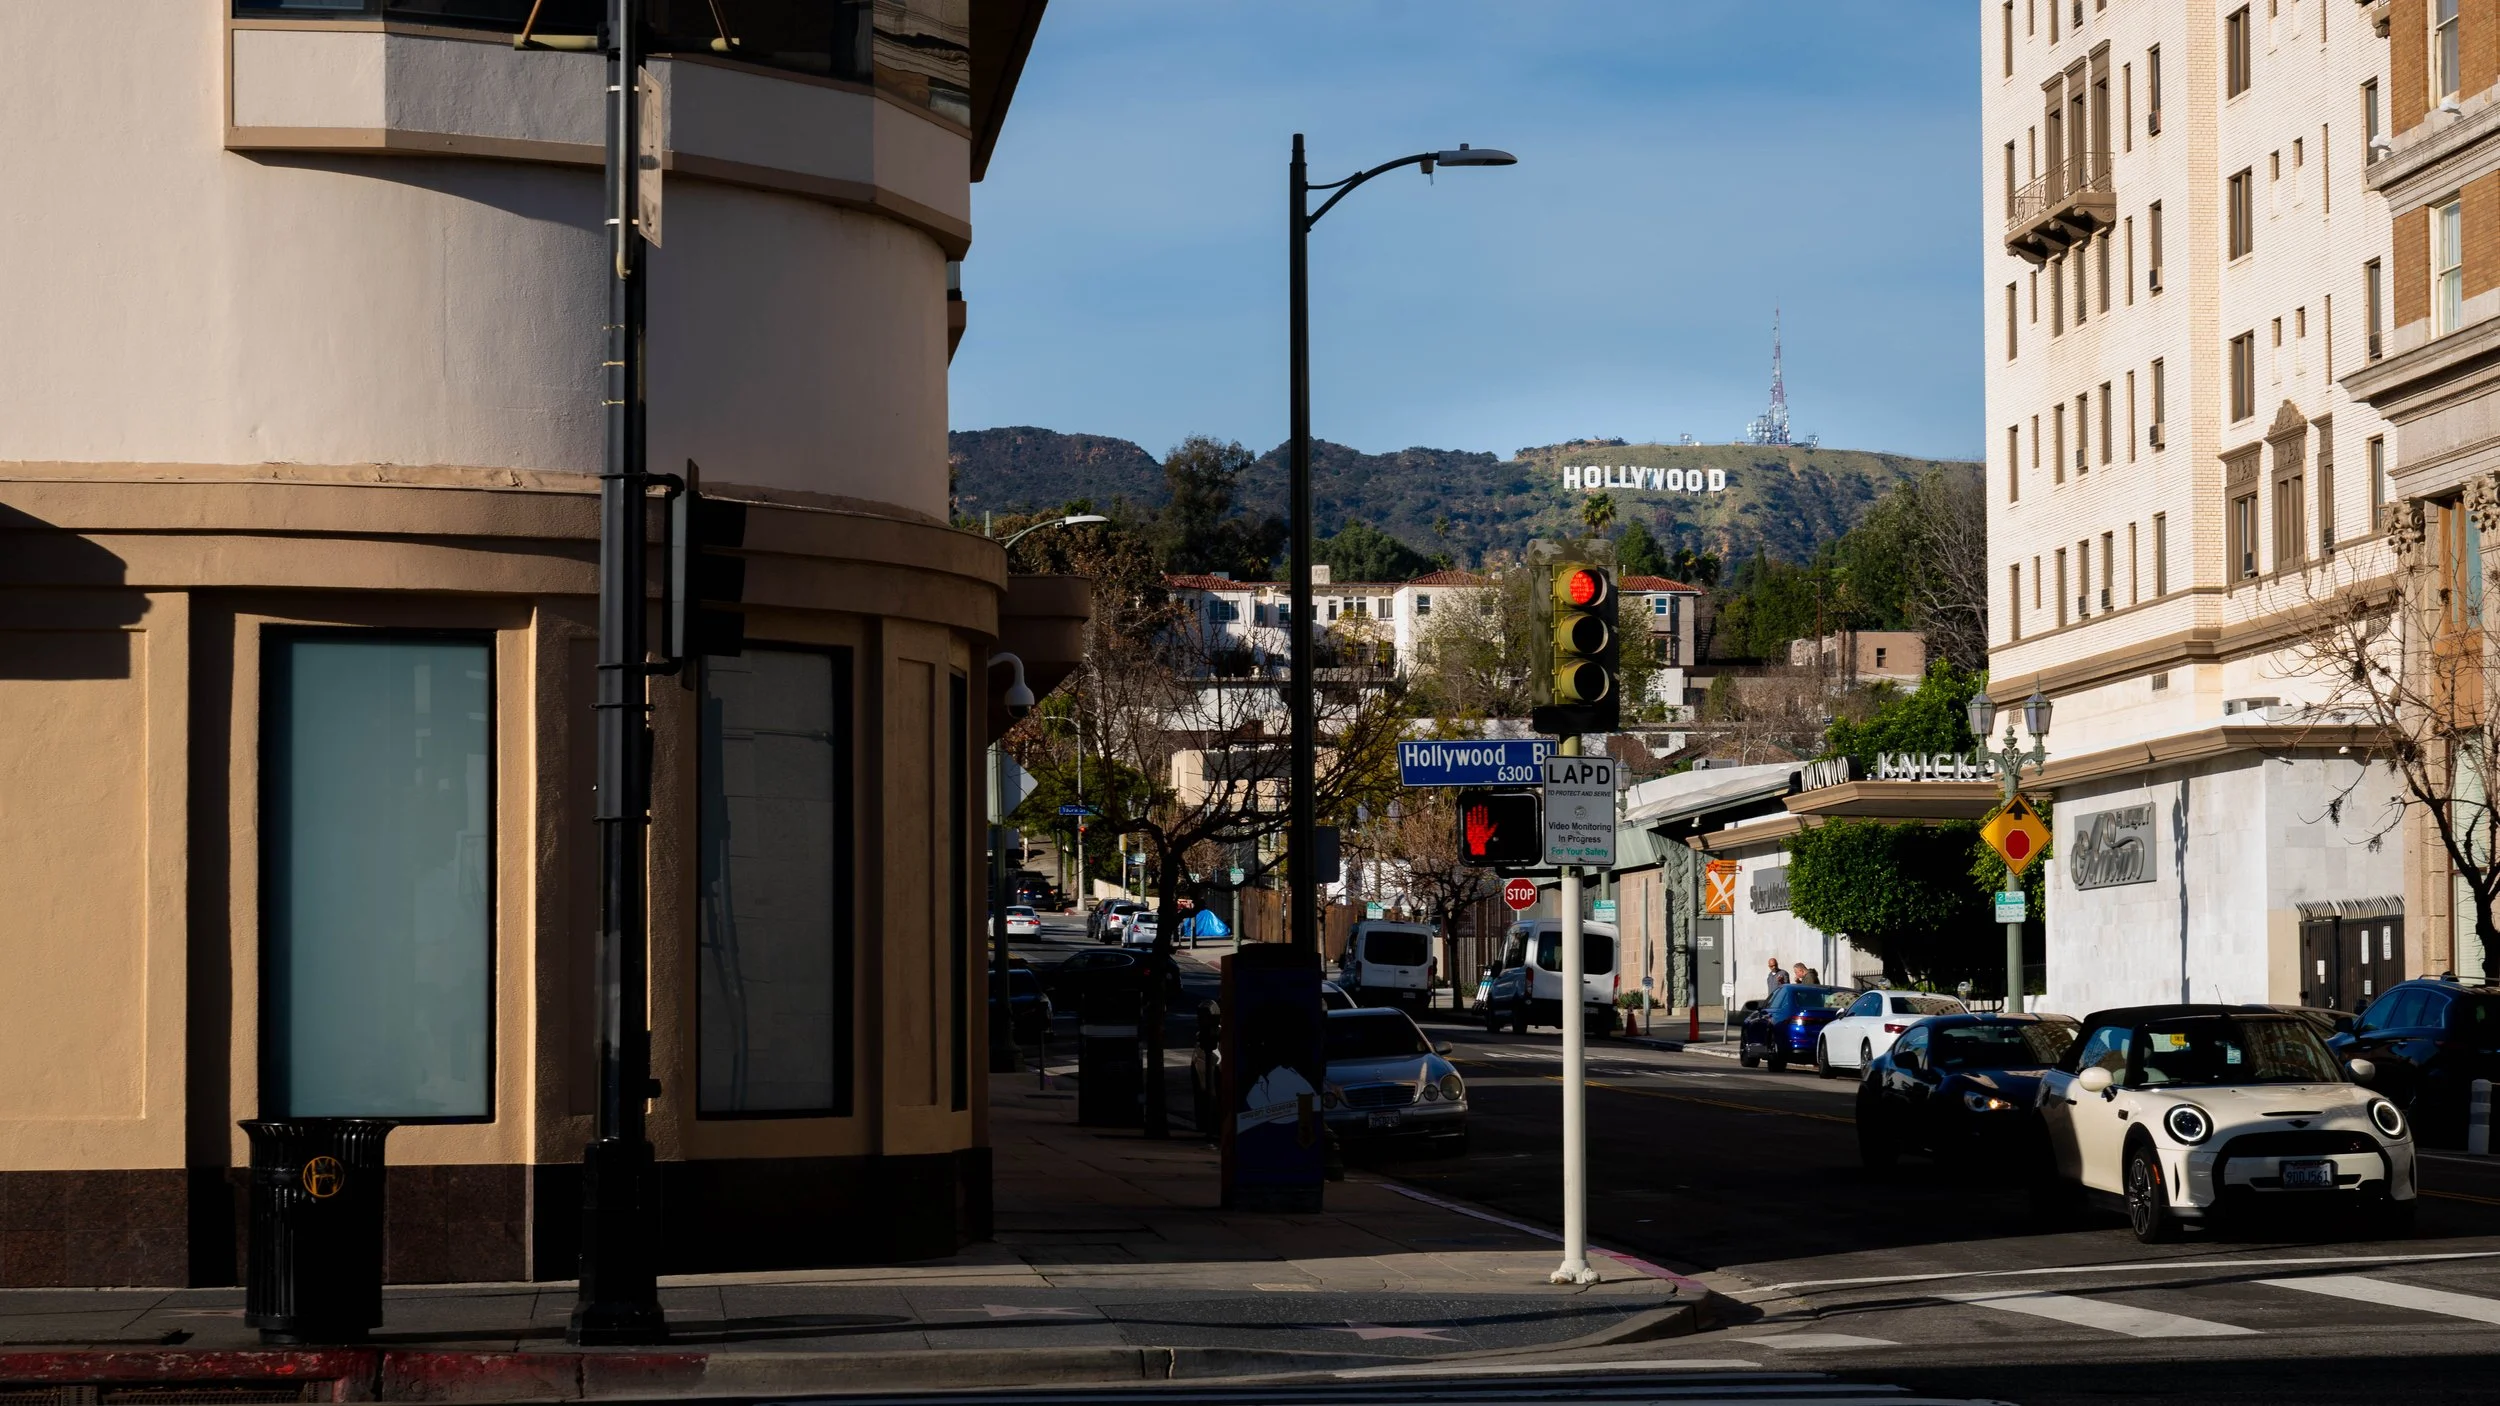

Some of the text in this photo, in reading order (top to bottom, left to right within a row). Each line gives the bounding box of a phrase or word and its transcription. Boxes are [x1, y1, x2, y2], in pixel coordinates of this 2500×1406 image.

[1563, 465, 1726, 492] HOLLYWOOD
[1404, 743, 1506, 773] Hollywood
[1497, 765, 1534, 782] 6300
[1548, 763, 1611, 785] LAPD
[1801, 756, 1850, 793] HOLLYWOOD
[1547, 789, 1555, 797] TO
[1593, 790, 1612, 798] SERVE
[1548, 821, 1612, 833] Video Monitoring
[1558, 834, 1602, 845] In Progress
[1551, 846, 1609, 858] For Your Safety
[1507, 888, 1535, 901] STOP
